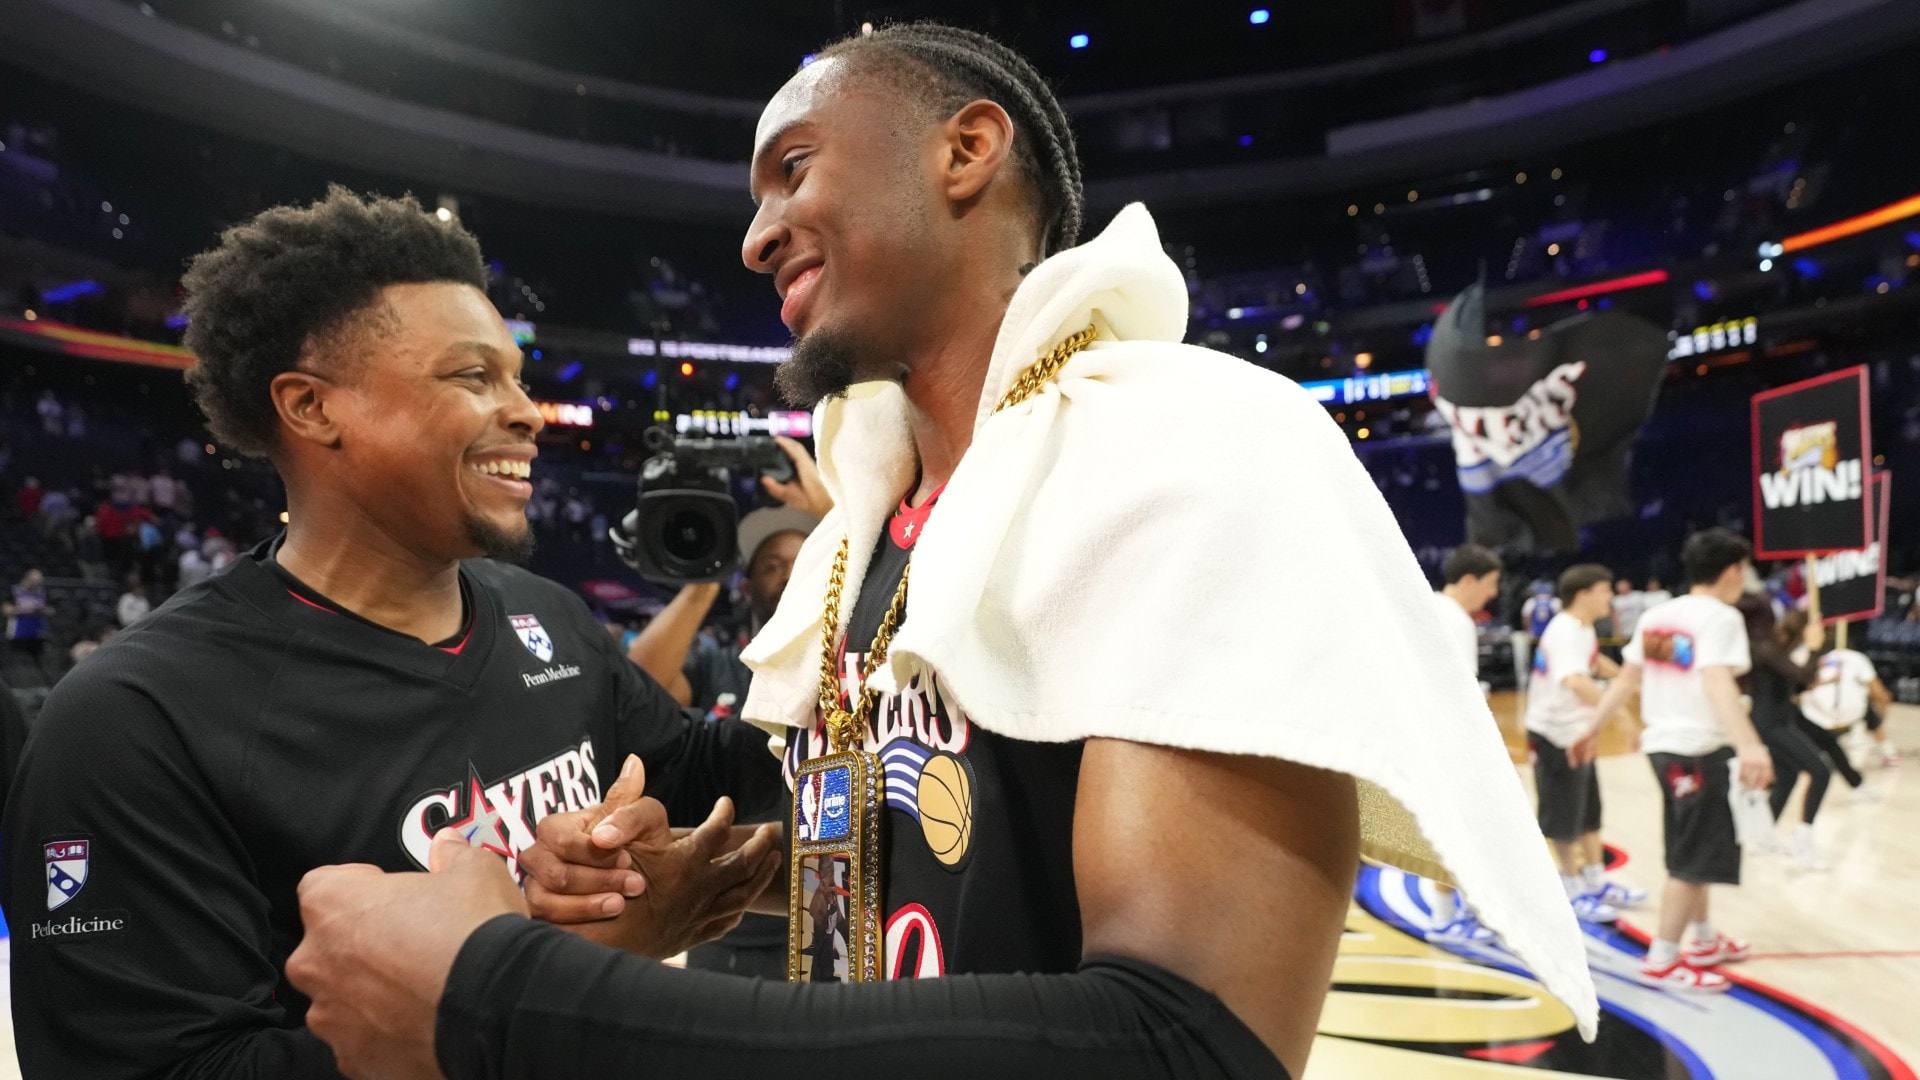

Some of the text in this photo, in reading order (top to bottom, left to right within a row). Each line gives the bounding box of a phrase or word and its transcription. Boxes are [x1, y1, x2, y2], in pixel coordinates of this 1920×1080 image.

[1760, 458, 1862, 509] WIN!
[522, 664, 581, 688] Penn Medicine
